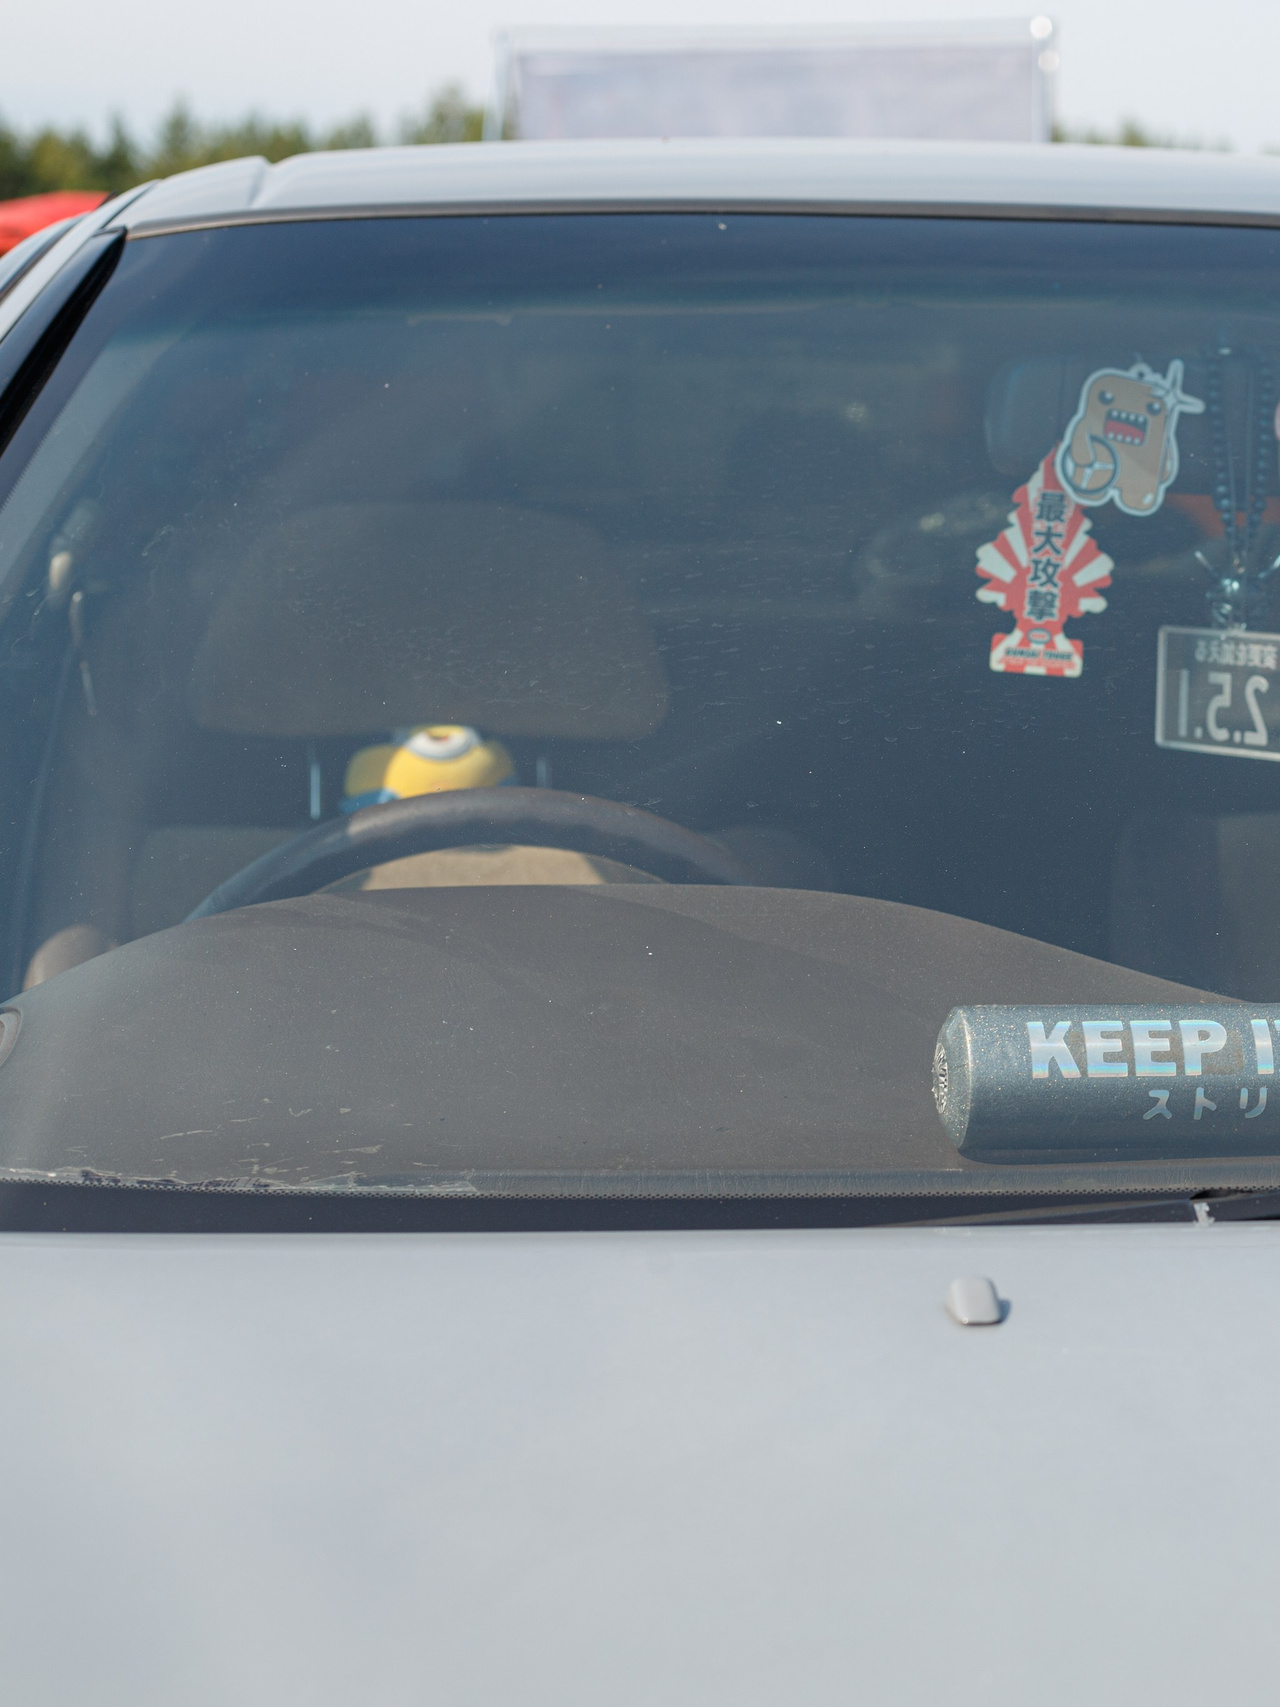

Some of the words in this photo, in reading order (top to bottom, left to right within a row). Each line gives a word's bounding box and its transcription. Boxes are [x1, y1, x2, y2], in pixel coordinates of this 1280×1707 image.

[1026, 490, 1068, 621] 最大攻撃
[1026, 1019, 1228, 1079] KEEP
